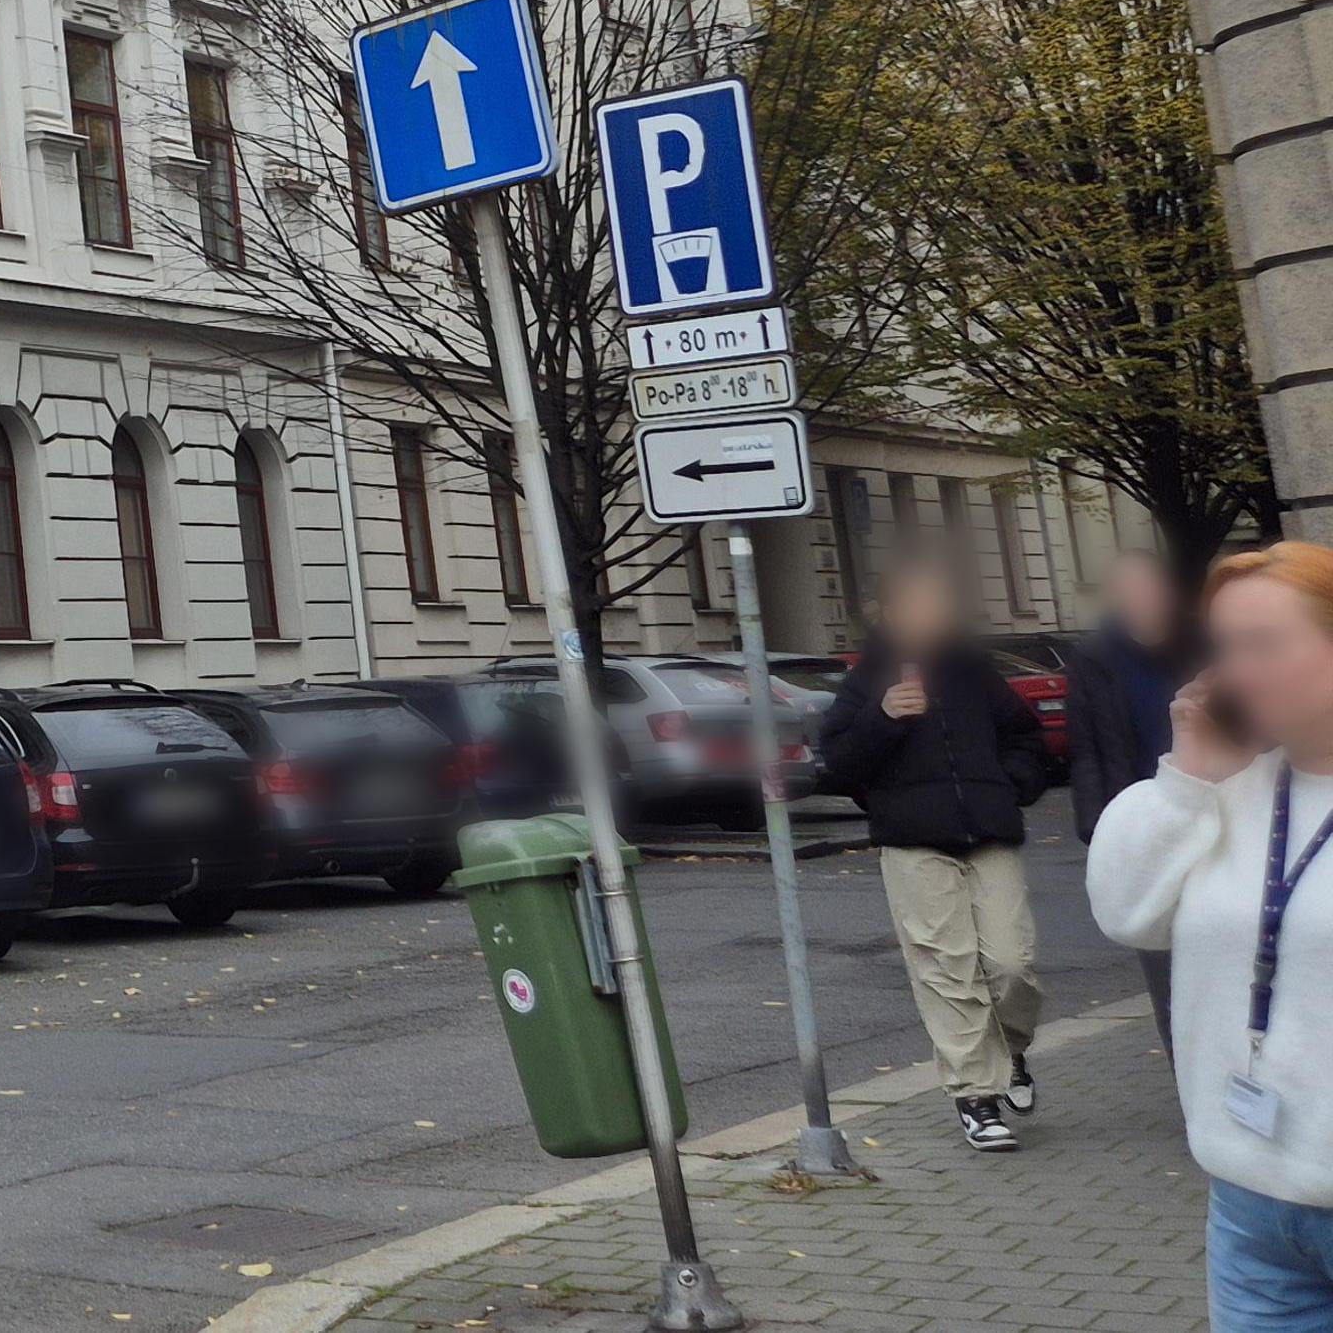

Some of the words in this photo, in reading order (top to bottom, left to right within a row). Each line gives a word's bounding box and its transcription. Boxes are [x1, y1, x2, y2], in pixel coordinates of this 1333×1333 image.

[638, 113, 705, 235] P
[679, 328, 706, 353] 80
[715, 330, 737, 349] m
[645, 380, 697, 407] Po-Pá
